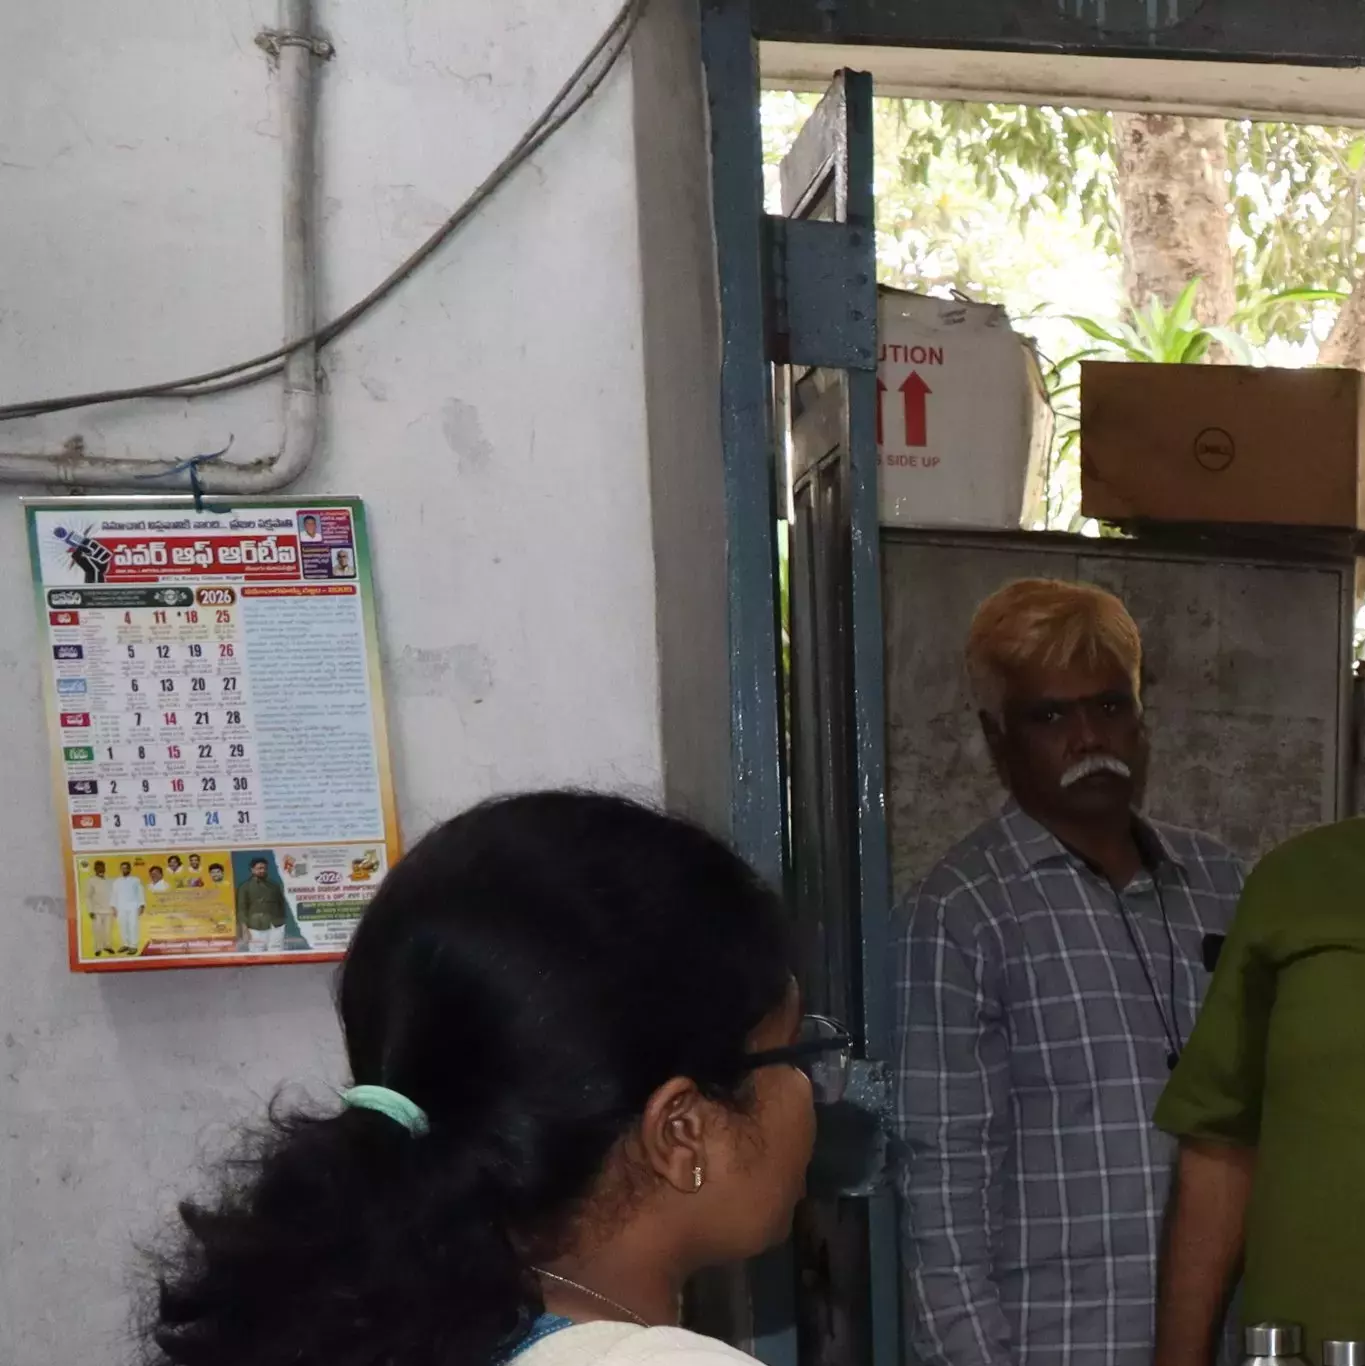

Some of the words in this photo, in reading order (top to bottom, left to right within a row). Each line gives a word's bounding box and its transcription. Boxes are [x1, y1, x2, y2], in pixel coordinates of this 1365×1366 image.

[887, 454, 918, 468] SIDE
[922, 456, 941, 468] UP
[114, 541, 168, 566] పవర్
[172, 540, 214, 567] ఆఫ్
[201, 590, 232, 605] 2026
[124, 611, 131, 625] 4
[153, 611, 167, 624] 11
[185, 611, 198, 624] 18
[216, 610, 230, 623] 25
[127, 645, 135, 659] 5
[156, 645, 170, 659] 12
[188, 644, 202, 657] 19
[219, 644, 233, 657] 26
[131, 678, 139, 692] 6
[160, 678, 174, 691] 13
[192, 677, 206, 691] 20
[223, 677, 237, 690] 27
[135, 713, 142, 726] 7
[164, 712, 177, 725] 14
[195, 712, 209, 725] 21
[226, 711, 241, 724] 28
[107, 747, 113, 760] 1
[138, 746, 146, 759] 8
[167, 745, 181, 759] 15
[198, 745, 212, 758] 22
[230, 744, 245, 758] 29
[110, 780, 118, 794] 2
[142, 779, 149, 793] 9
[171, 779, 184, 792] 16
[202, 778, 216, 791] 23
[233, 777, 248, 791] 30
[114, 814, 121, 828] 3
[143, 813, 156, 827] 10
[174, 812, 187, 826] 17
[205, 811, 219, 825] 24
[238, 811, 250, 824] 31
